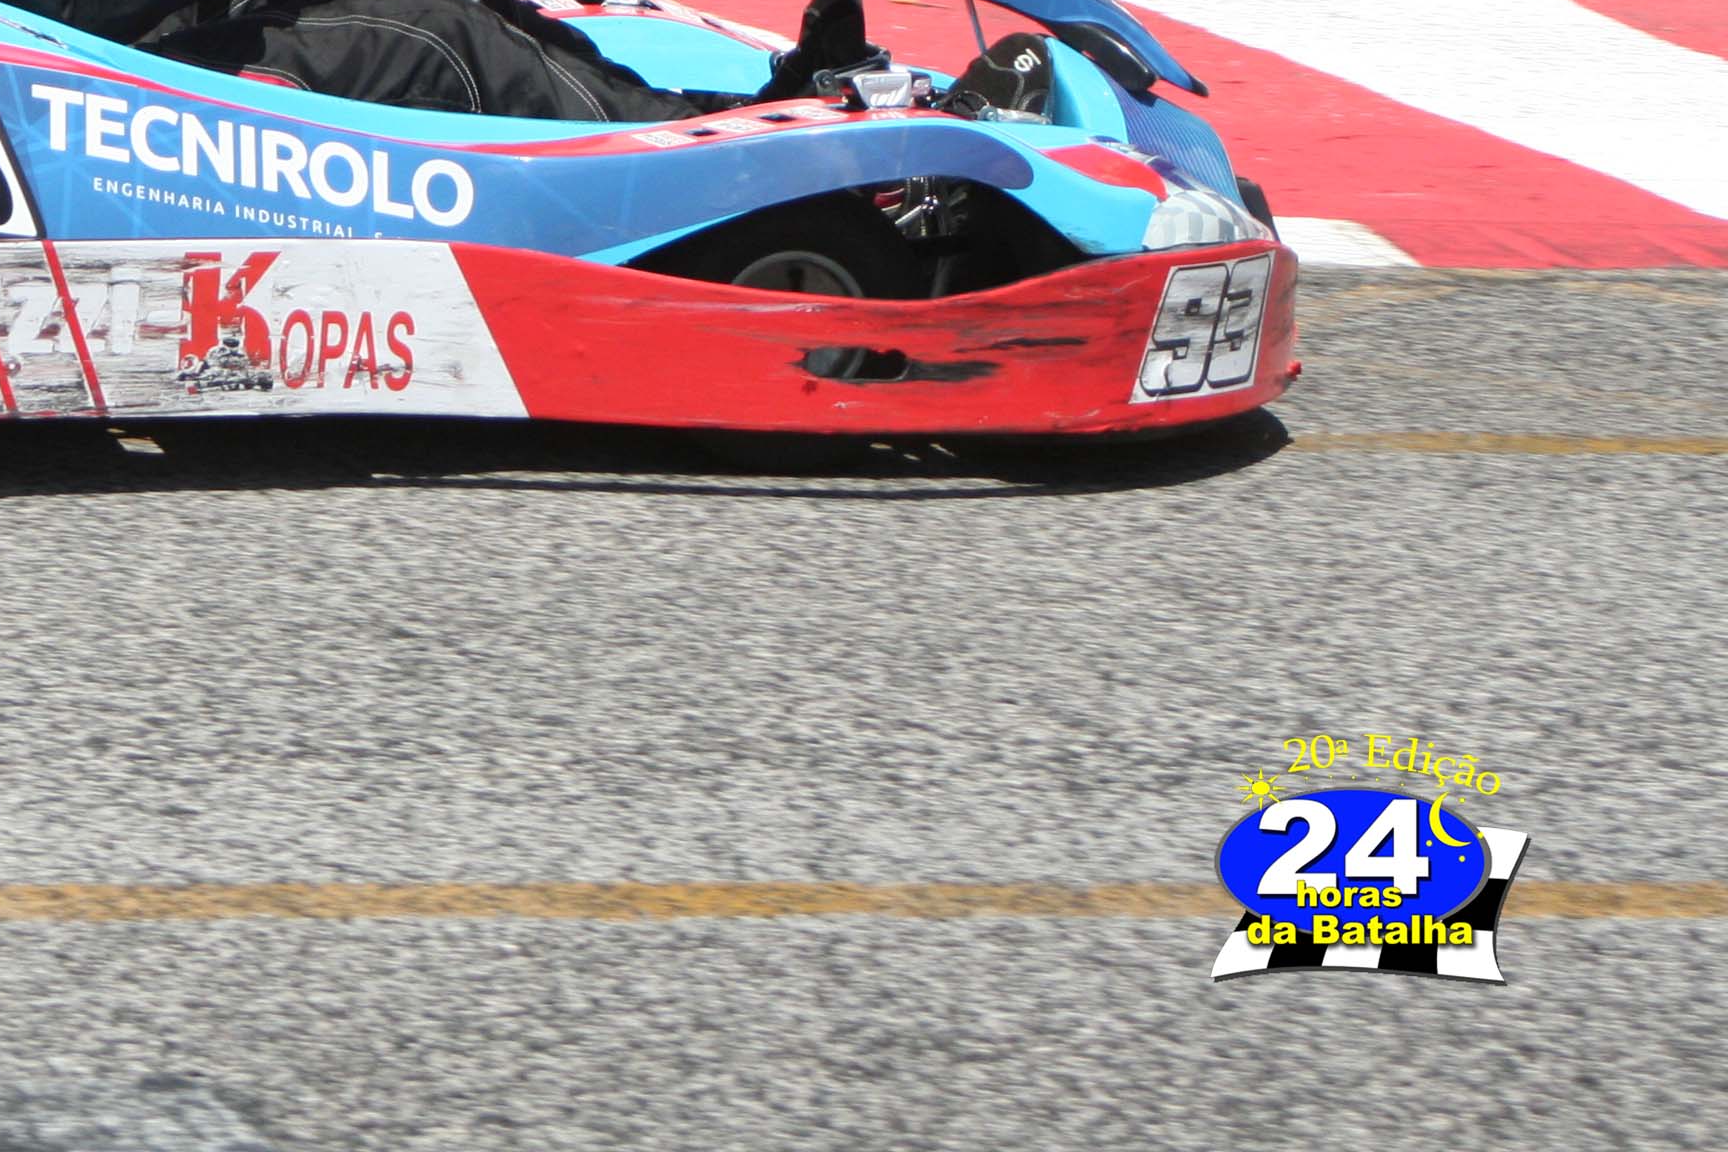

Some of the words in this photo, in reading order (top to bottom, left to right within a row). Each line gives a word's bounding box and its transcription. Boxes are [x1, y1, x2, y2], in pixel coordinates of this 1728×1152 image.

[31, 84, 473, 227] TECNIROLO
[93, 177, 226, 216] ENGENHARIA
[1139, 253, 1271, 397] 93
